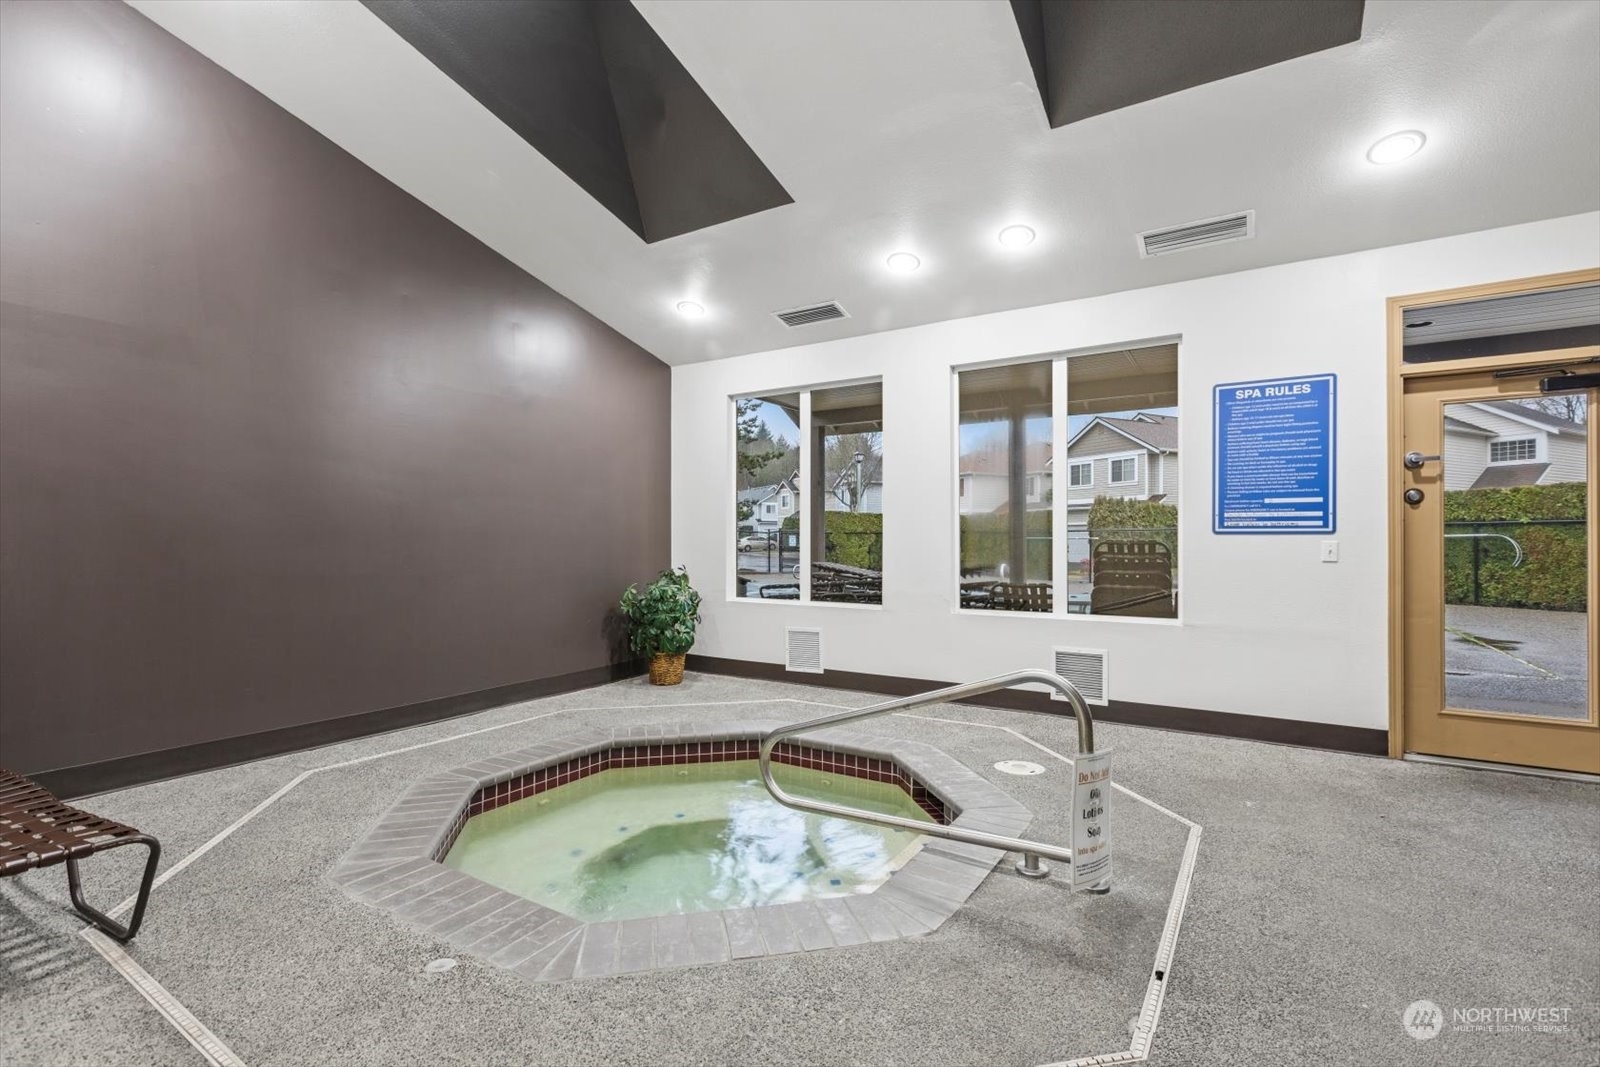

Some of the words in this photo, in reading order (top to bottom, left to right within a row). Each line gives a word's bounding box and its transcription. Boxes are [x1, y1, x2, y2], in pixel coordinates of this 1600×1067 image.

[1235, 390, 1261, 400] SPA
[1265, 384, 1311, 397] RULES
[1078, 772, 1089, 783] Do
